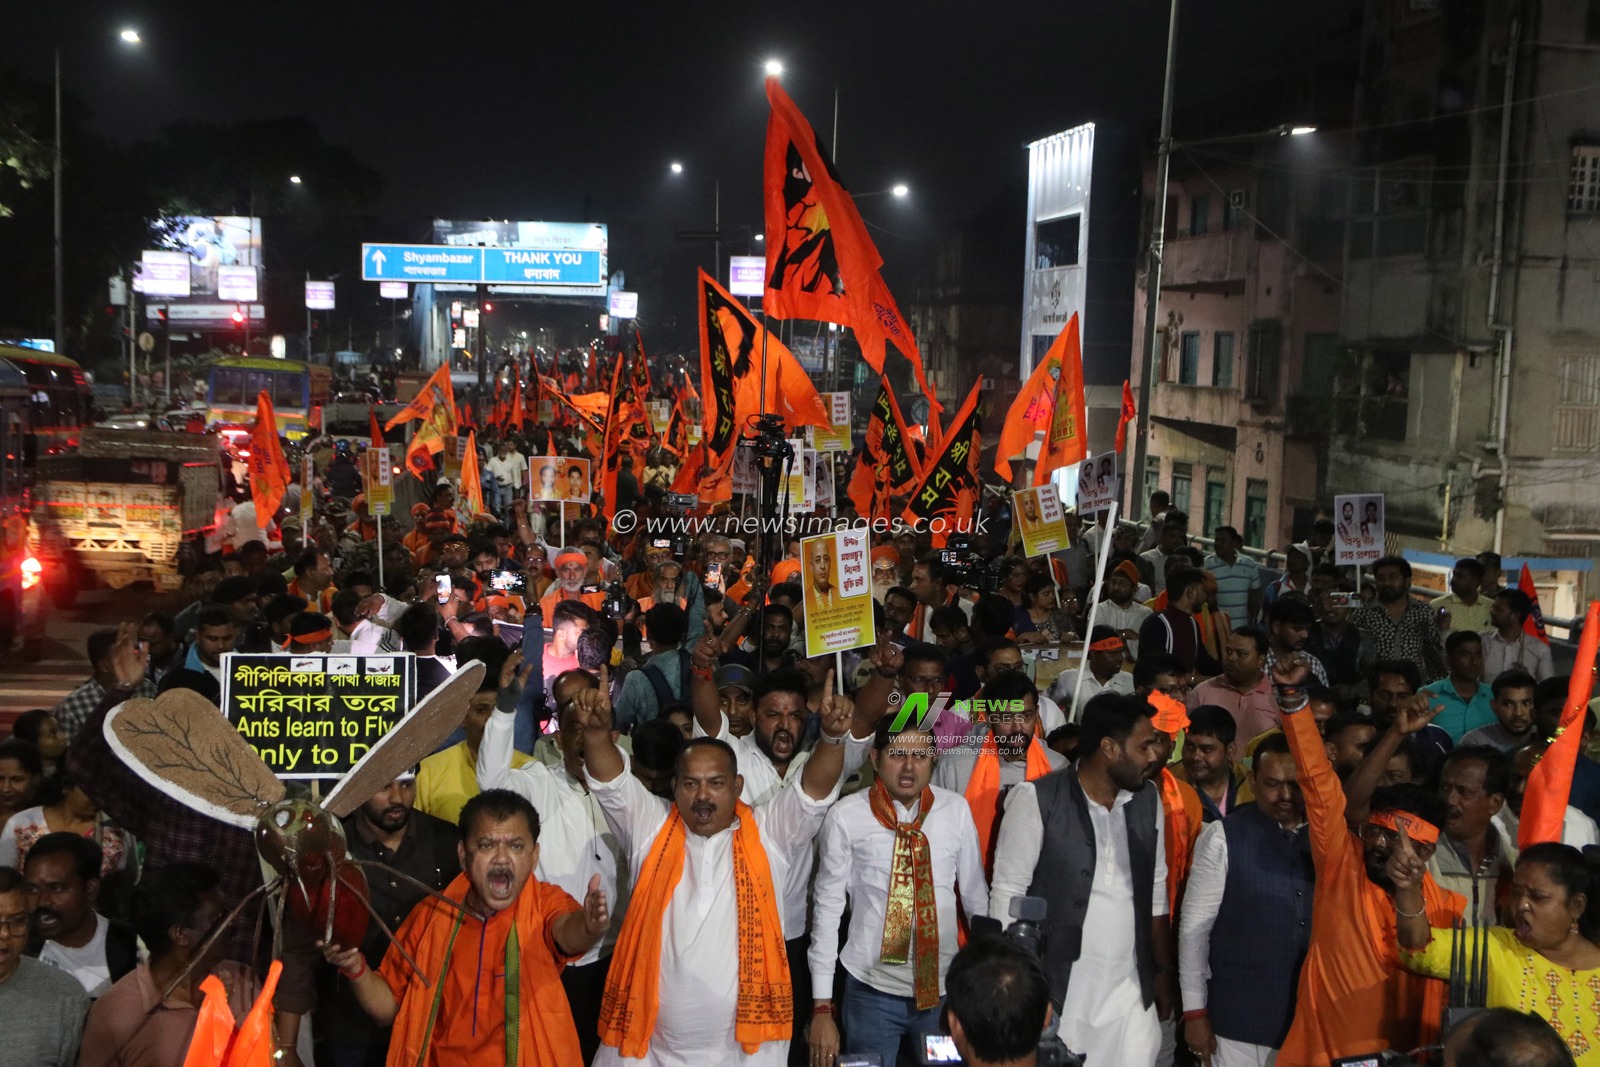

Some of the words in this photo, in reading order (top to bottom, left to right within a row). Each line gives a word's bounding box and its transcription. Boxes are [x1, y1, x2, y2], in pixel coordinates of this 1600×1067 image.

[403, 251, 474, 265] Shyambazar
[503, 251, 550, 265] THANK
[552, 252, 582, 265] YOU
[523, 267, 561, 280] ধন্যবাদ
[234, 665, 327, 687] পীপিলিকার
[330, 673, 360, 687] পাখা
[364, 673, 401, 687] গজায়
[235, 689, 334, 713] মরিবার
[340, 695, 400, 713] তরে
[236, 715, 280, 737] Ants
[286, 715, 334, 737] learn
[341, 716, 359, 737] to
[250, 743, 302, 770] nly
[311, 743, 339, 765] to
